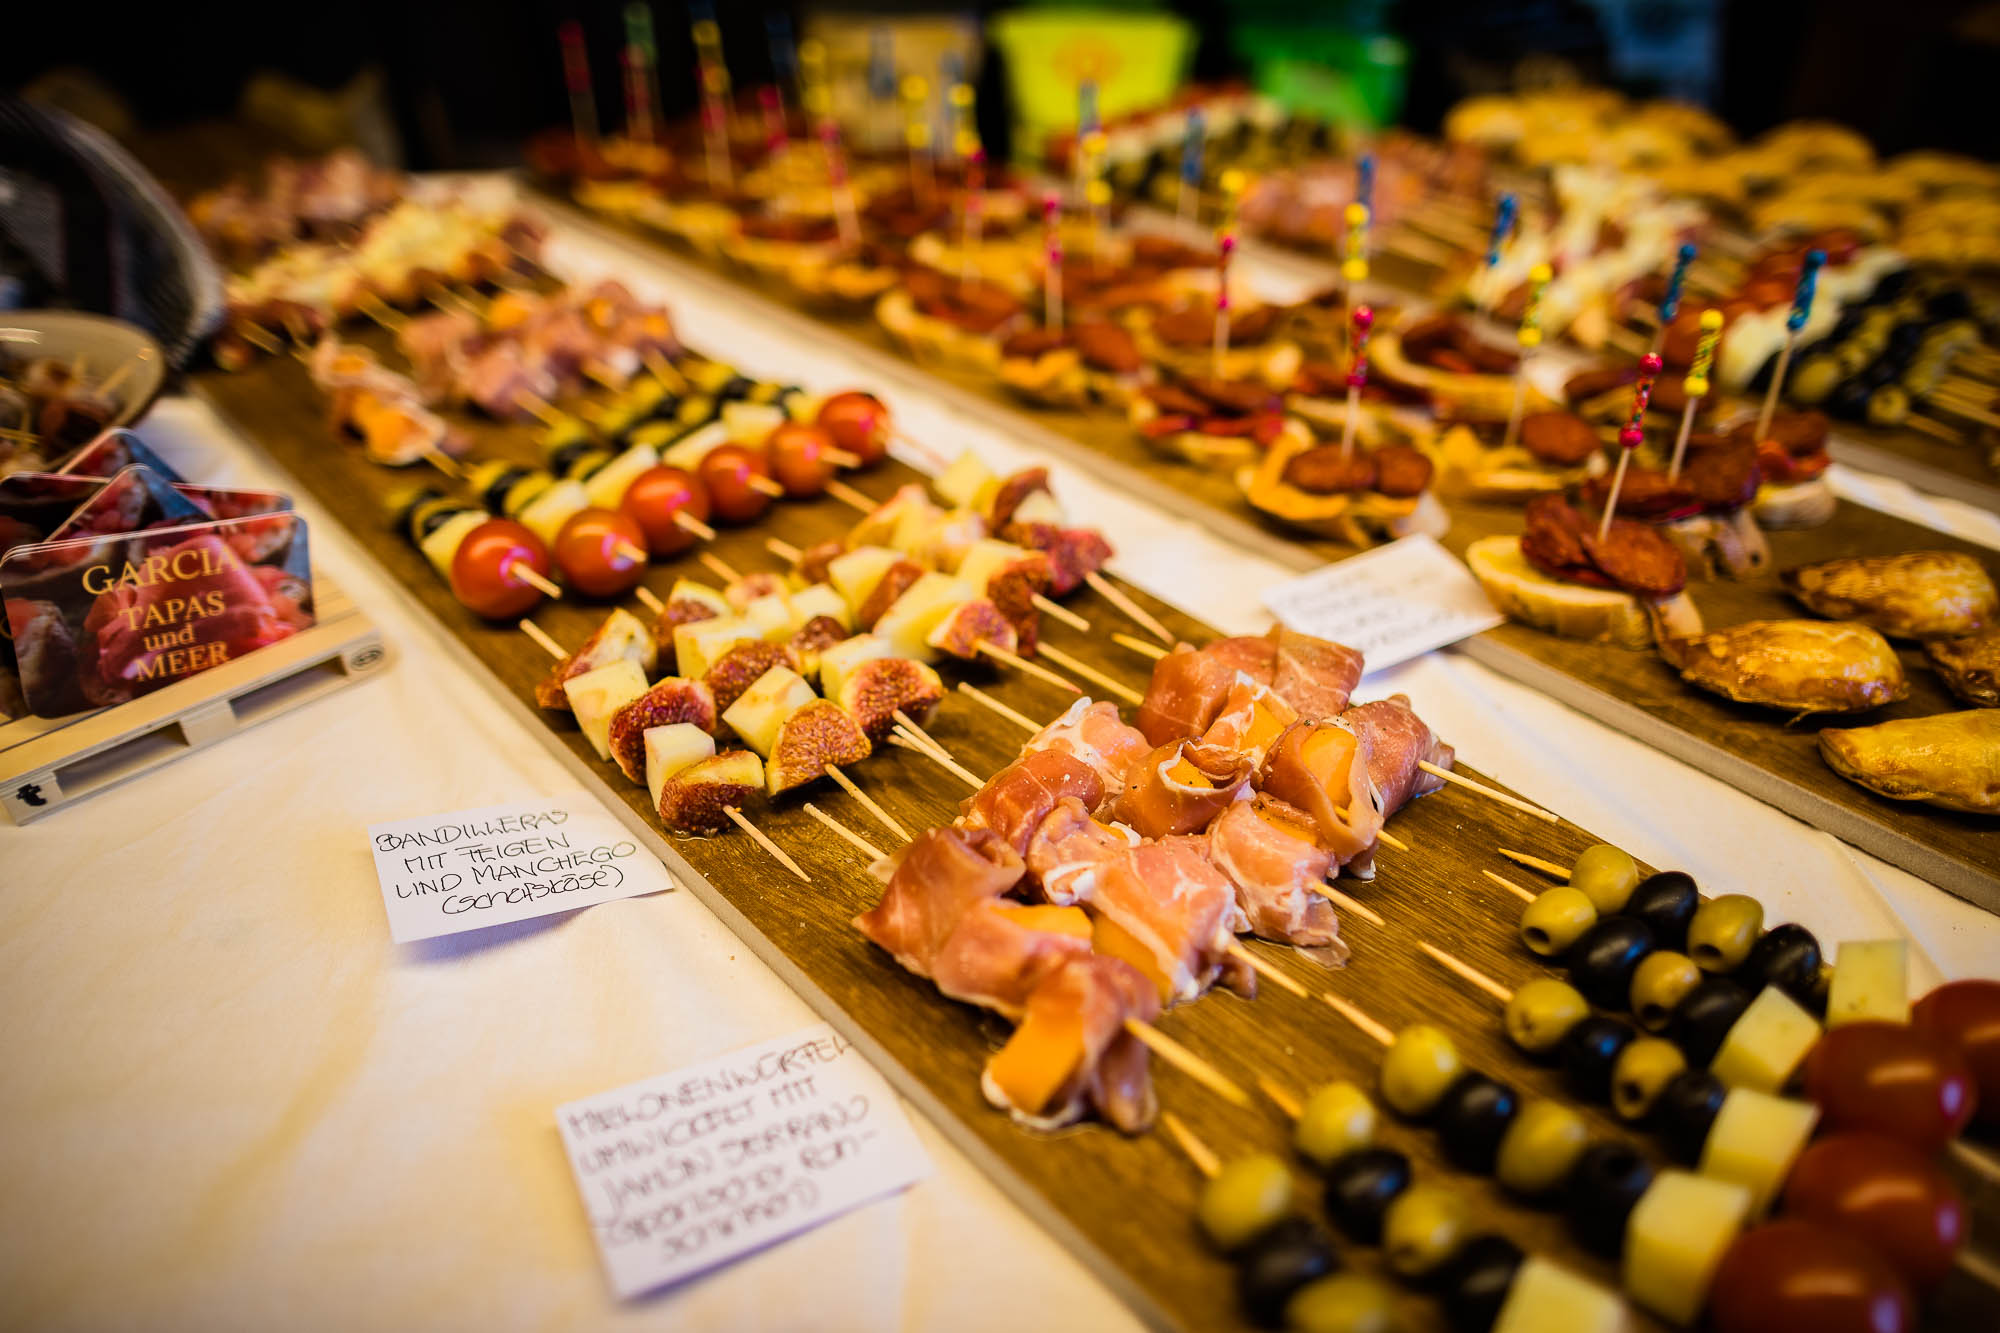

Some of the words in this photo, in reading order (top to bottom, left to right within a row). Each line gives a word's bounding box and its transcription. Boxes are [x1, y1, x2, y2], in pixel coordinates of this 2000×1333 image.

[82, 545, 240, 596] GARCIA
[119, 590, 226, 632] TAPAS
[144, 623, 196, 652] und
[136, 641, 230, 682] MEER
[396, 873, 462, 899] UND
[471, 841, 637, 884] MANCHEGO
[405, 852, 448, 874] MIT
[768, 1074, 818, 1108] MIT
